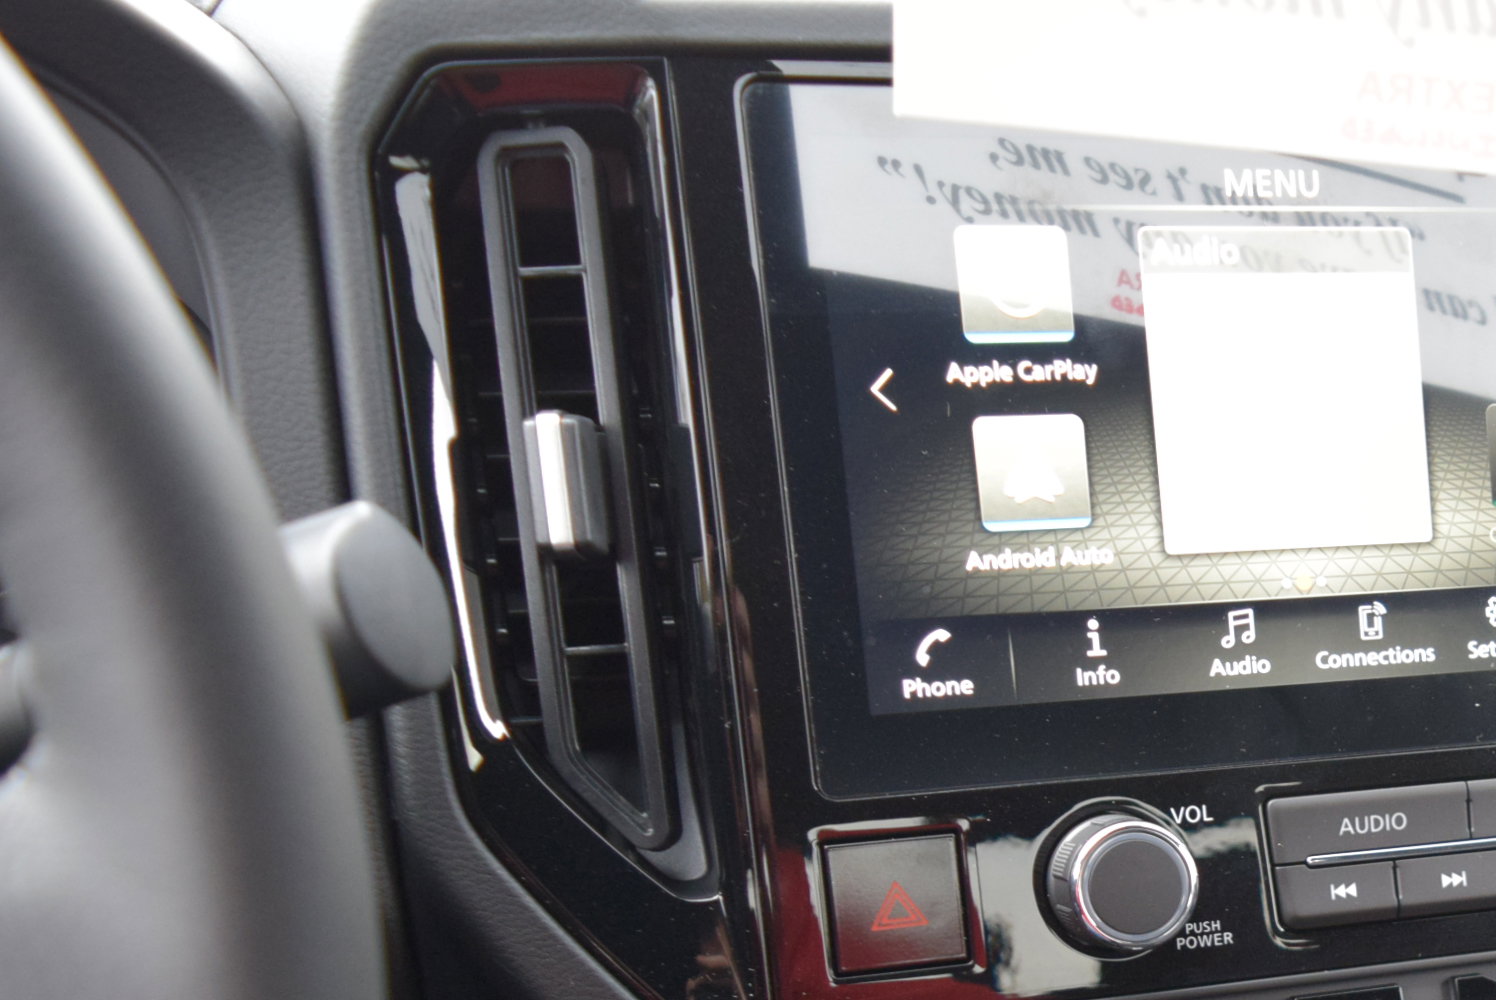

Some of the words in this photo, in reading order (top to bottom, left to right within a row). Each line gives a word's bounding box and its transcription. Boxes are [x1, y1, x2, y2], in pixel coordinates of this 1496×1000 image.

[1222, 168, 1321, 199] MENU
[1150, 234, 1241, 267] Audio
[946, 360, 1014, 387] Apple
[1017, 358, 1098, 385] CarPlay
[965, 546, 1056, 572] Android
[1060, 544, 1115, 567] Auto
[1209, 657, 1272, 678] Audio
[1314, 645, 1436, 671] Connections
[902, 677, 975, 699] Phone
[1075, 666, 1121, 687] Info
[1170, 804, 1215, 824] VOL
[1339, 812, 1408, 836] AUDIO
[1185, 919, 1221, 936] PUSH
[1176, 931, 1234, 950] POWER
